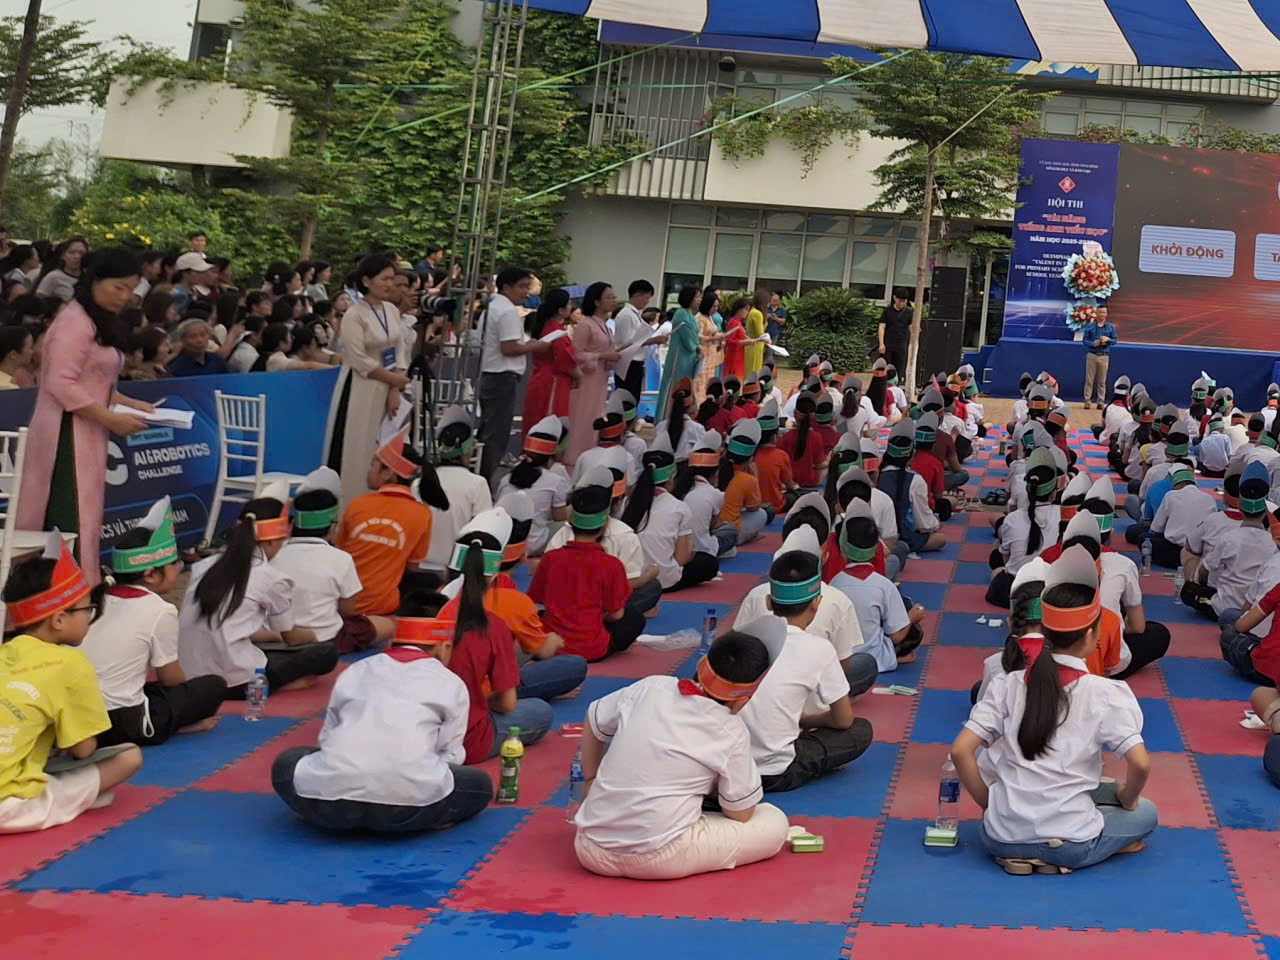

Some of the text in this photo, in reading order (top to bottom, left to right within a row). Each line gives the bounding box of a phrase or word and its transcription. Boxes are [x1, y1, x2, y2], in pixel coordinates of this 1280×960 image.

[1048, 197, 1083, 208] HỘI THI
[1151, 242, 1224, 260] KHỞI ĐỘNG
[135, 443, 210, 466] AI&ROBOTICS
[138, 465, 183, 479] CHALLENGE
[113, 519, 126, 535] VÀ
